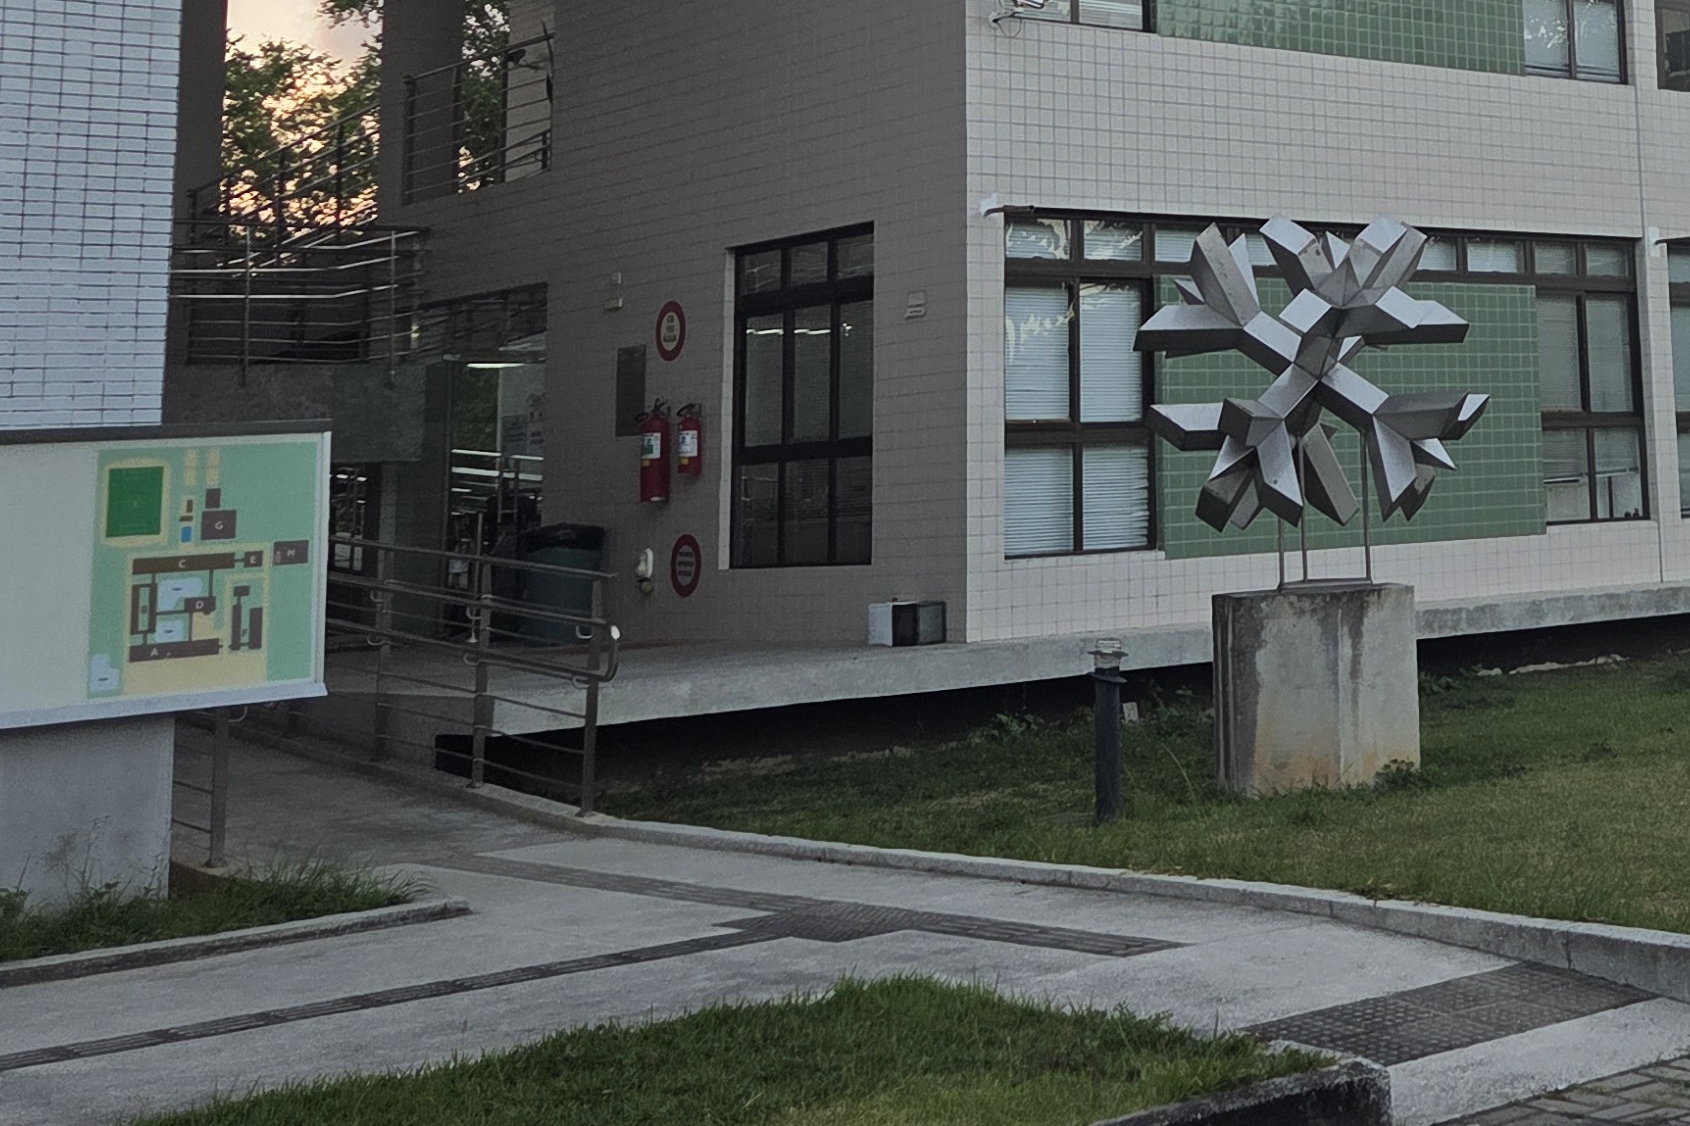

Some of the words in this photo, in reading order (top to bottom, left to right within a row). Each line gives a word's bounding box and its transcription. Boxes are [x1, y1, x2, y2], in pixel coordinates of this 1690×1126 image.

[215, 521, 223, 530] G
[178, 559, 186, 568] C
[250, 555, 257, 564] E
[195, 601, 204, 609] D
[150, 648, 159, 656] A
